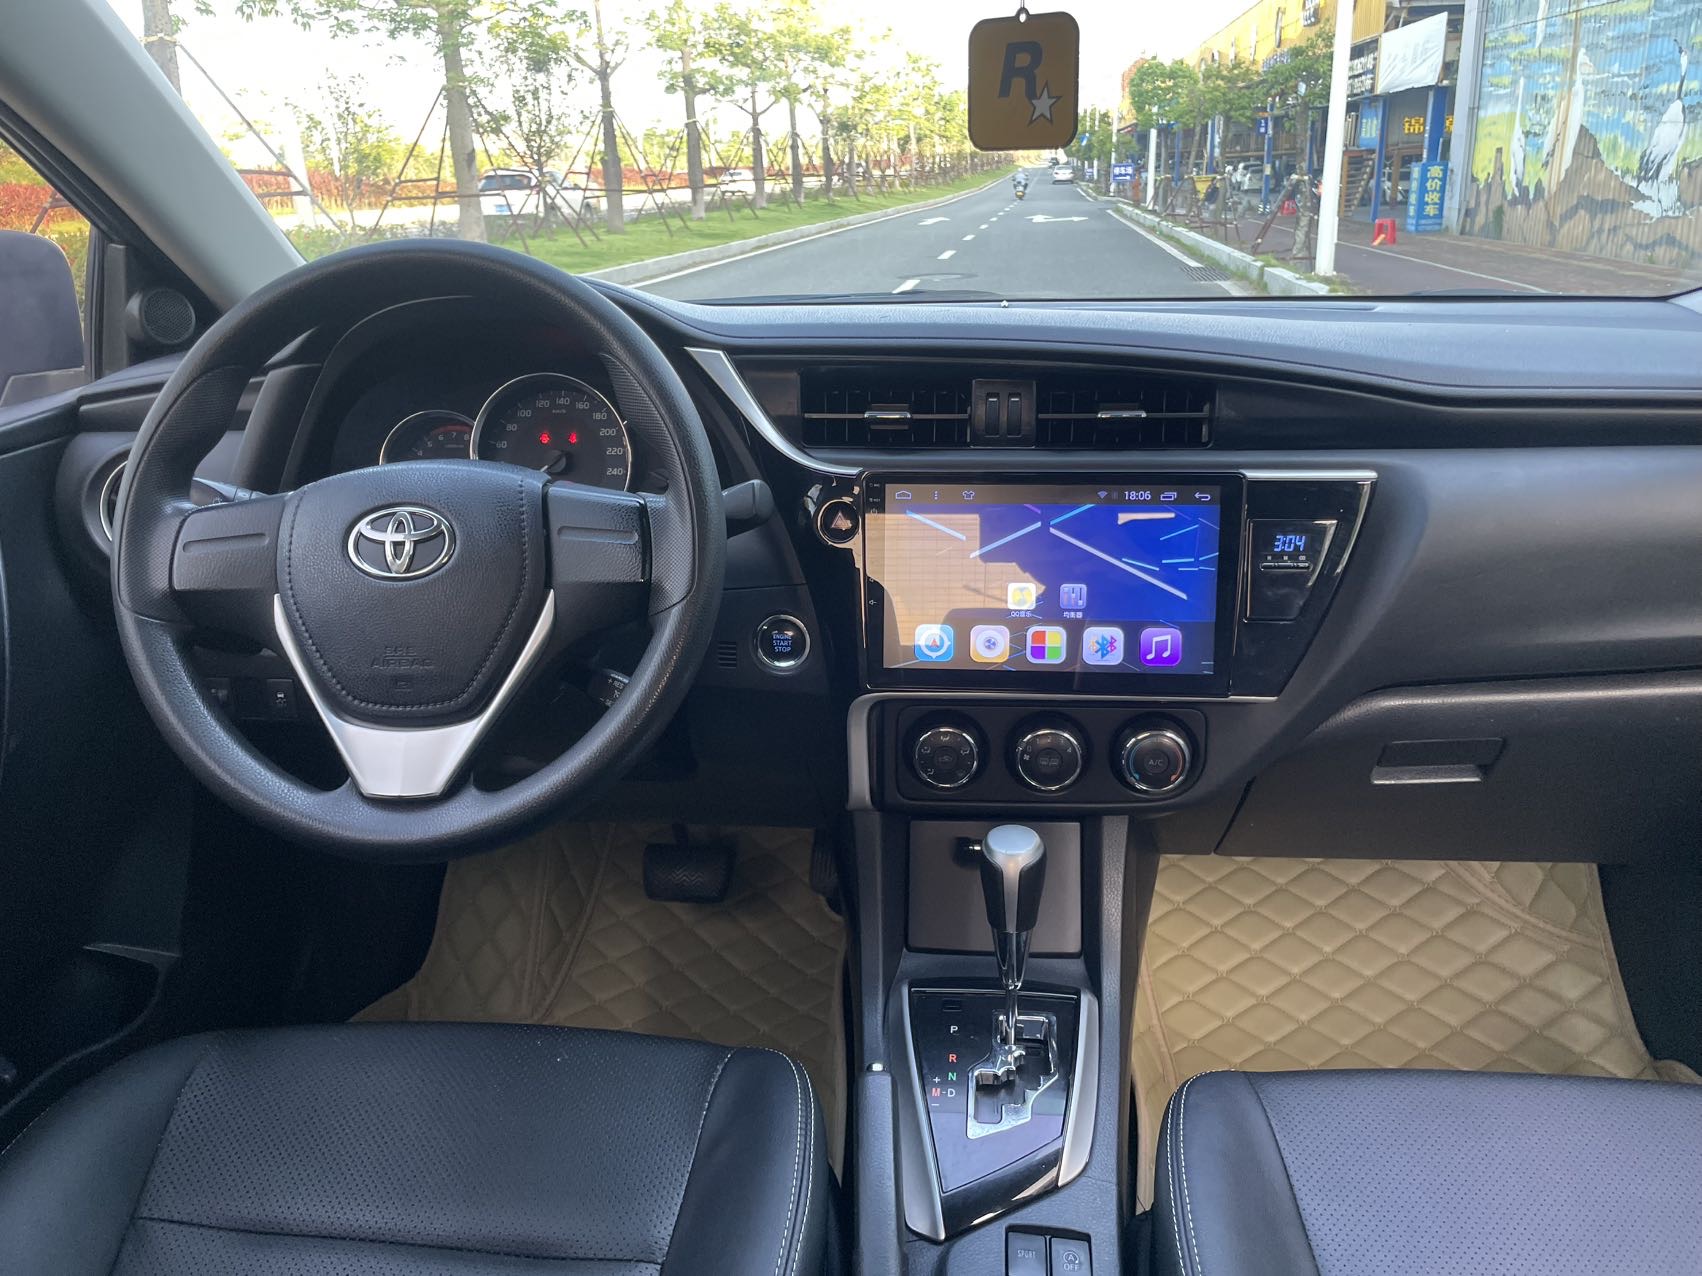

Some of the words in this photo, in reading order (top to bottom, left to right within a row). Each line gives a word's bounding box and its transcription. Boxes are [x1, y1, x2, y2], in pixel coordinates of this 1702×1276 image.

[999, 41, 1043, 101] R
[1423, 165, 1445, 217] 高价收车
[535, 400, 550, 408] 120
[556, 397, 570, 405] 140
[575, 401, 590, 410] 160
[517, 409, 532, 418] 100
[592, 411, 608, 420] 180
[506, 423, 517, 431] 80
[451, 431, 457, 439] 7
[600, 428, 616, 436] 200
[606, 447, 623, 455] 220
[606, 467, 623, 476] 240
[1124, 490, 1152, 500] 18:06
[1273, 535, 1306, 552] 3:04
[950, 1025, 959, 1034] P
[948, 1053, 957, 1063] R
[948, 1072, 957, 1081] N
[931, 1087, 941, 1097] M
[947, 1088, 956, 1097] D
[1017, 1249, 1036, 1259] SPORT
[1063, 1263, 1079, 1272] OFF
